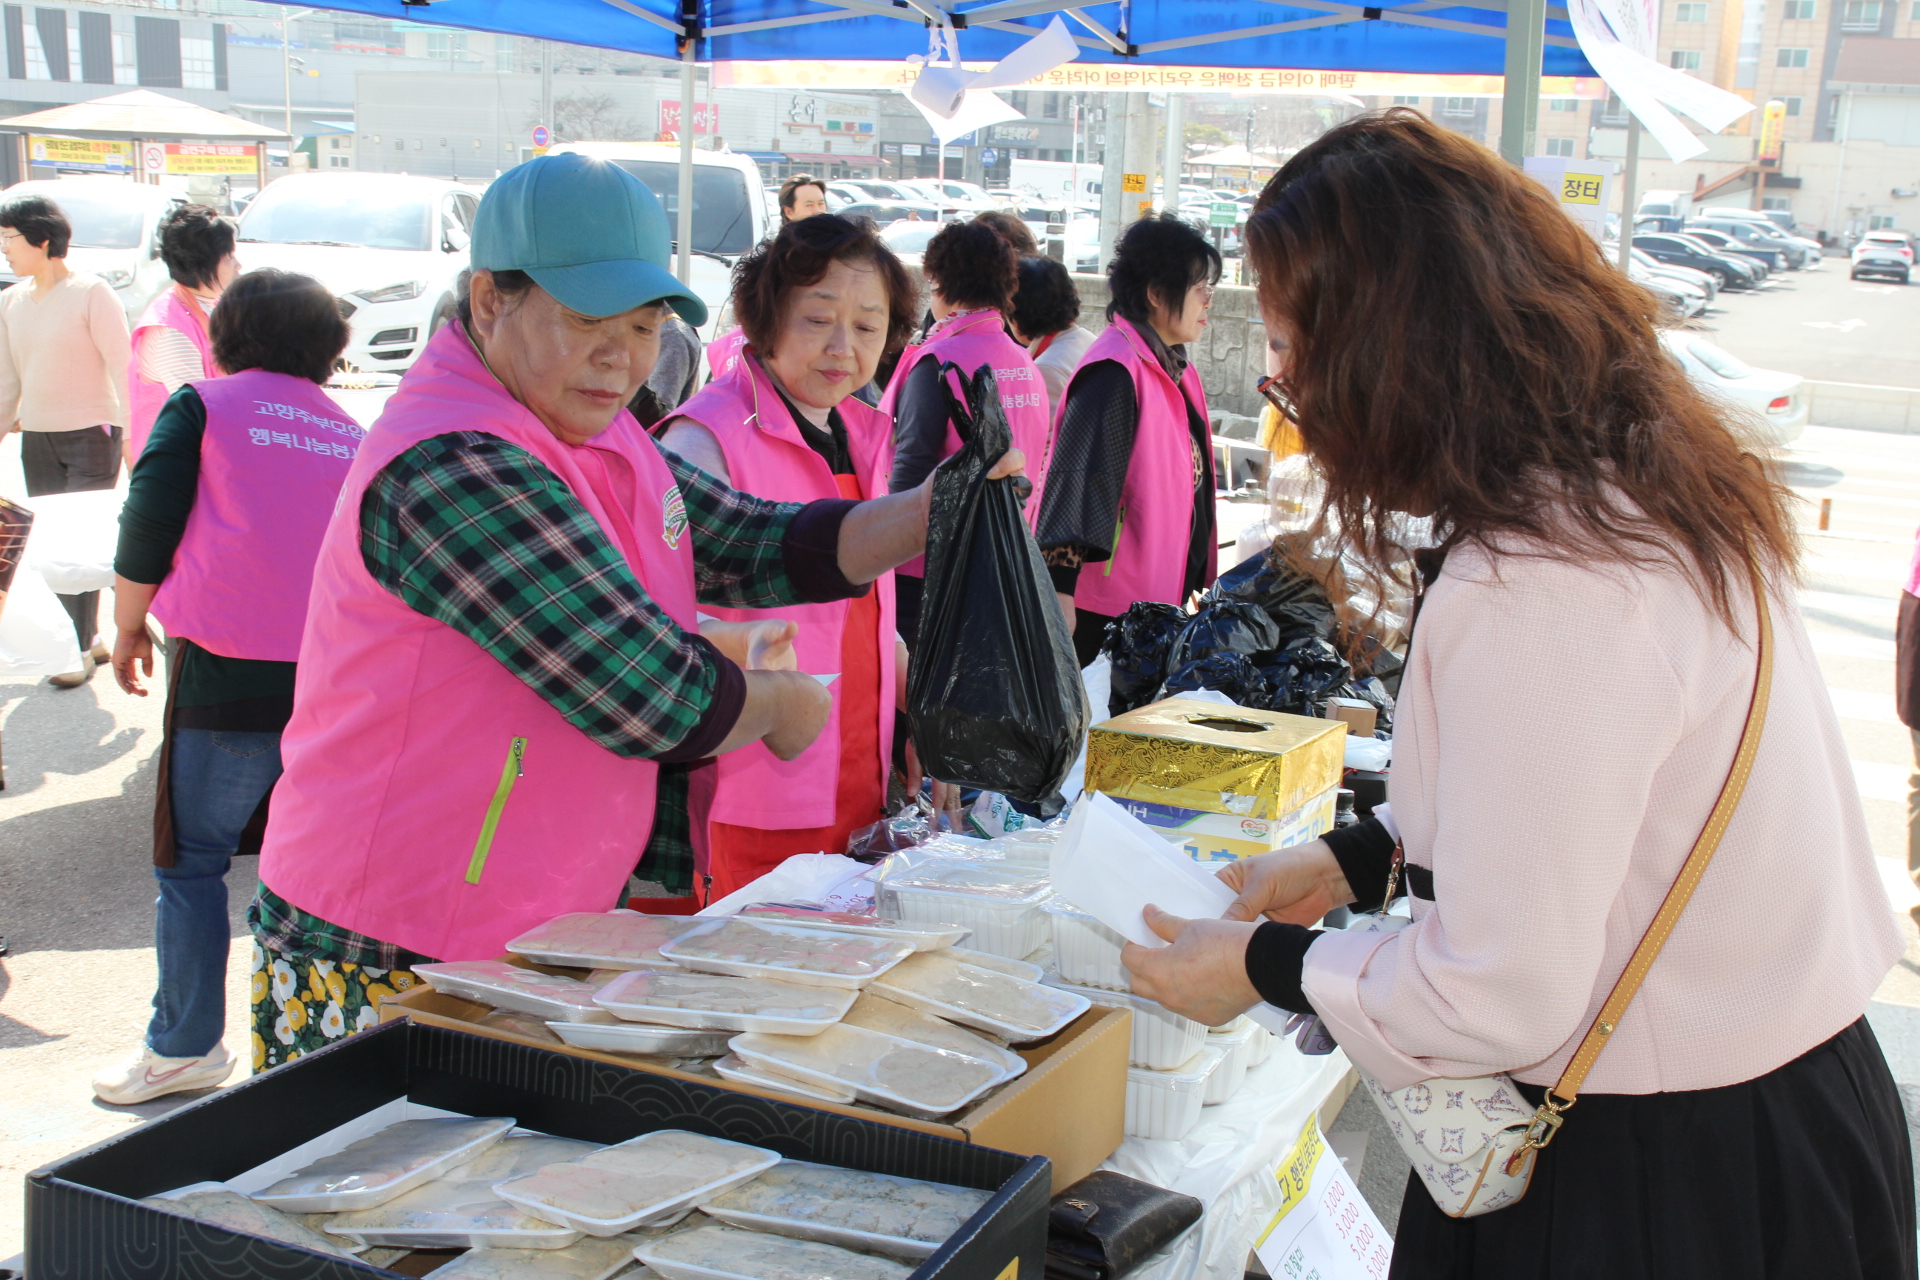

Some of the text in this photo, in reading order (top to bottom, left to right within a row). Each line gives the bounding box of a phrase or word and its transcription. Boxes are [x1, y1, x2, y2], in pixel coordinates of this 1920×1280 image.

[179, 144, 244, 156] 금연구역 안내문
[1564, 180, 1600, 200] 장터
[253, 400, 367, 441] 고향주부모임
[1283, 1180, 1345, 1280] 인절미 3,000
[1336, 1202, 1359, 1239] 3,000
[1350, 1223, 1374, 1261] 5,000
[1366, 1244, 1389, 1280] 5,000
